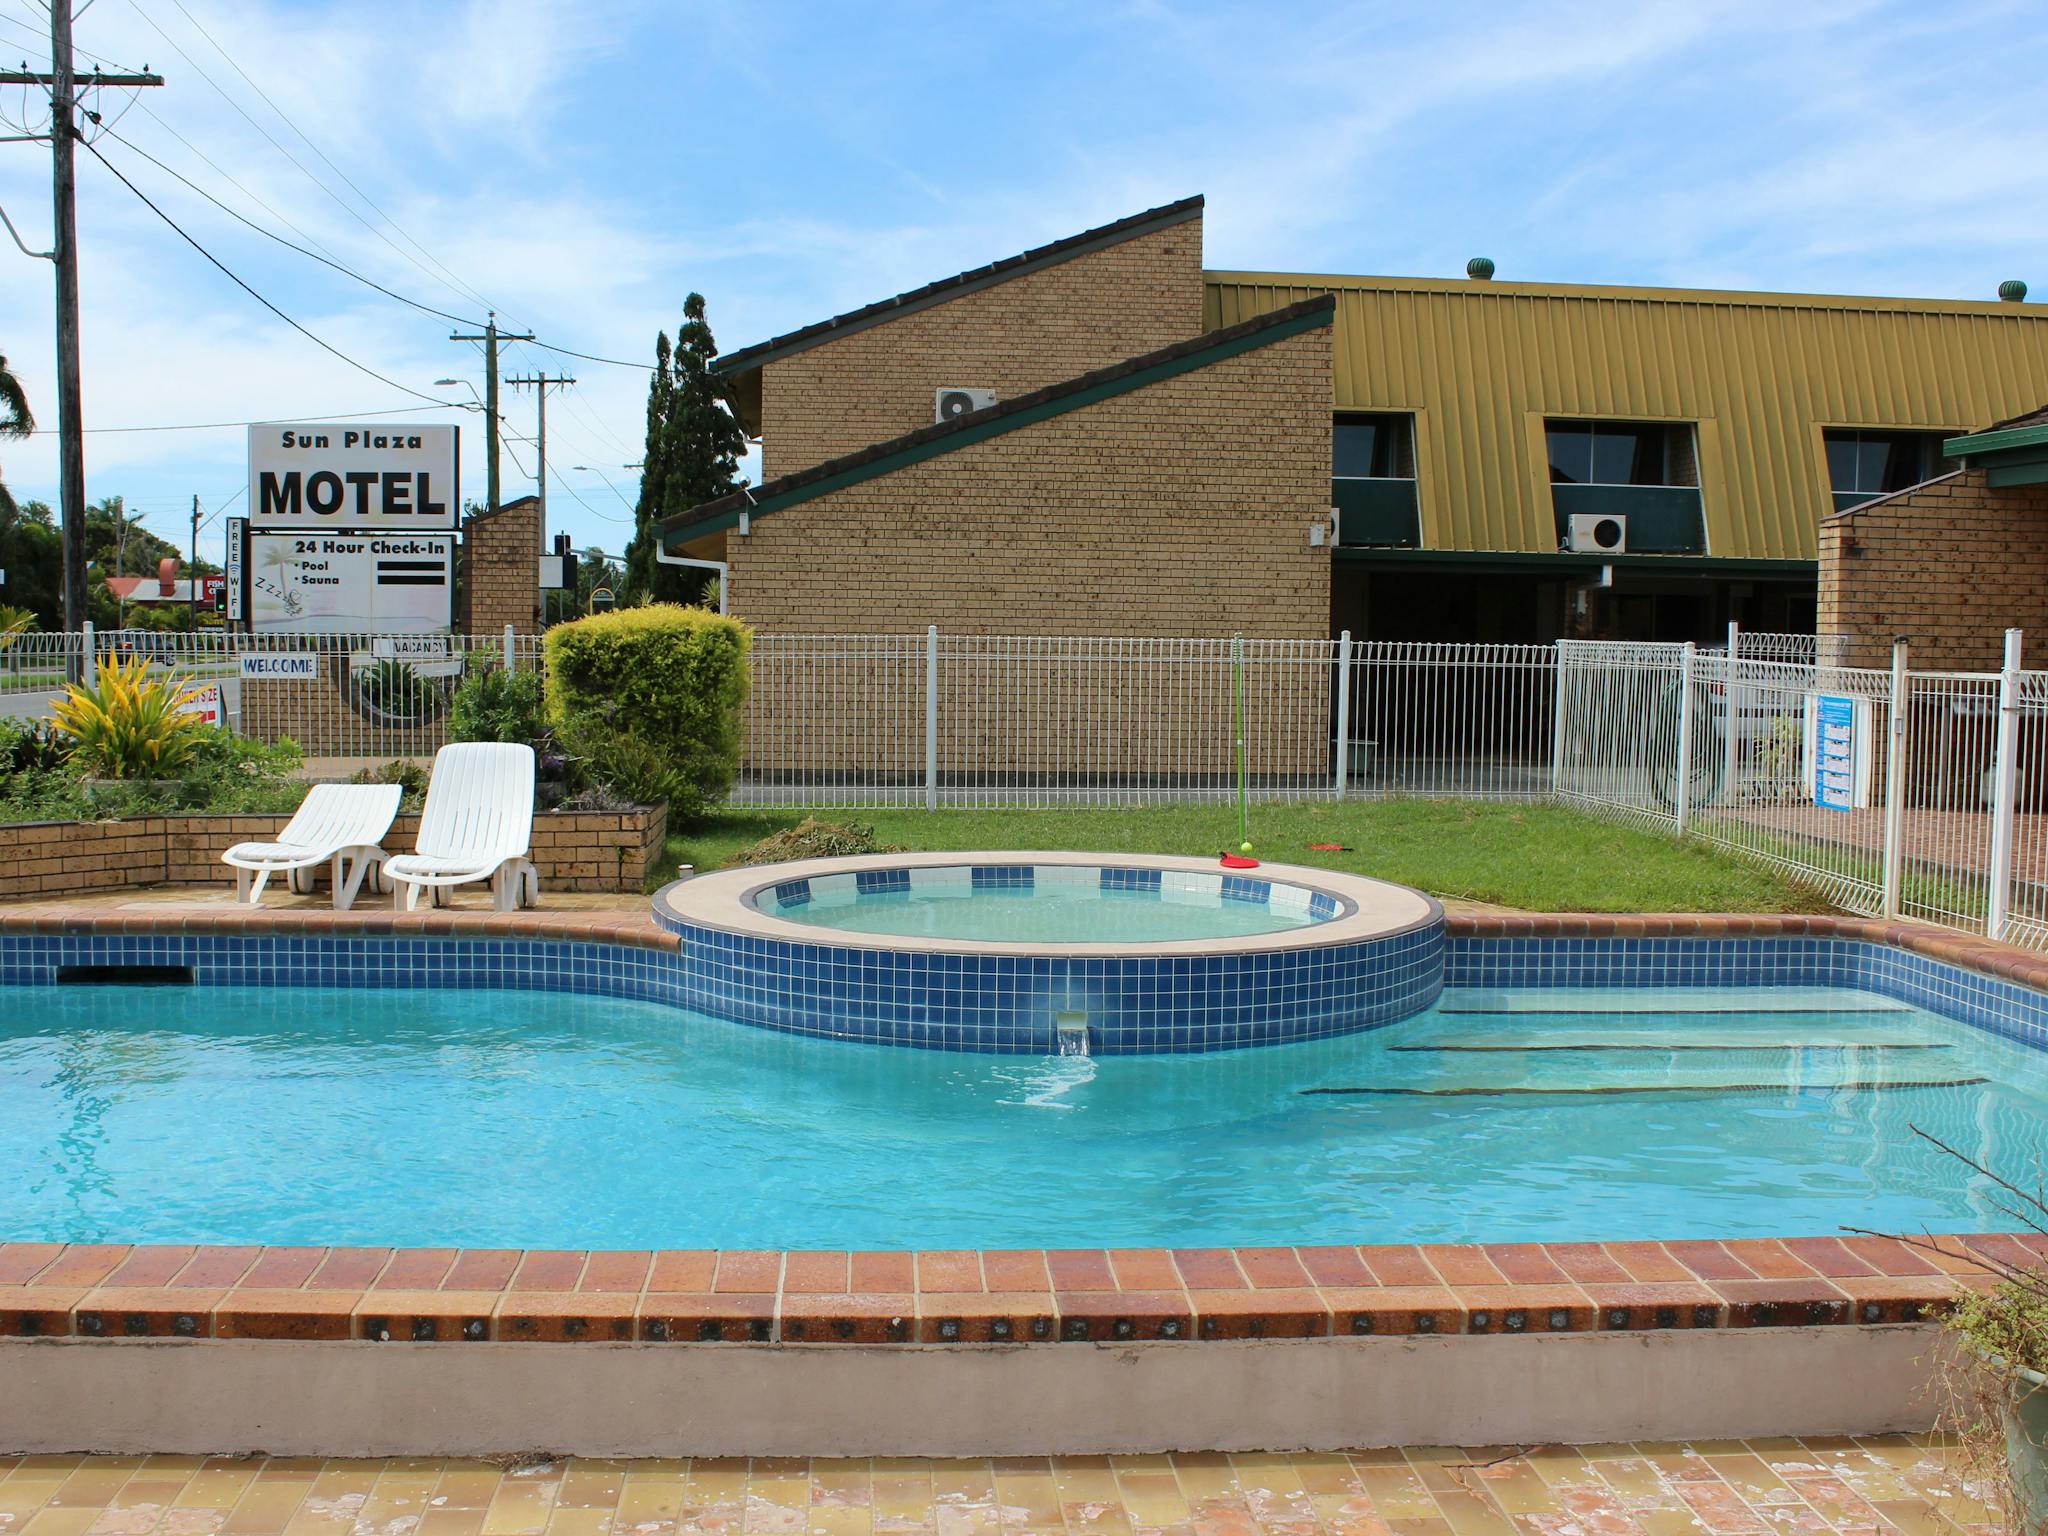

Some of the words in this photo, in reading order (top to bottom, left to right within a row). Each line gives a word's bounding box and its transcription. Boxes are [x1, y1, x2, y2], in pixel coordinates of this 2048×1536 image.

[282, 431, 329, 449] Sun
[344, 430, 422, 449] Plaza
[259, 470, 446, 515] MOTEL
[231, 522, 239, 562] FREE
[295, 541, 317, 554] 24
[323, 541, 365, 554] Hour
[371, 541, 445, 554] Check-In
[302, 561, 329, 571] Pool
[206, 580, 224, 588] FISH
[302, 576, 340, 585] Sauna
[230, 577, 239, 617] WIFI
[243, 659, 312, 673] WELCOME
